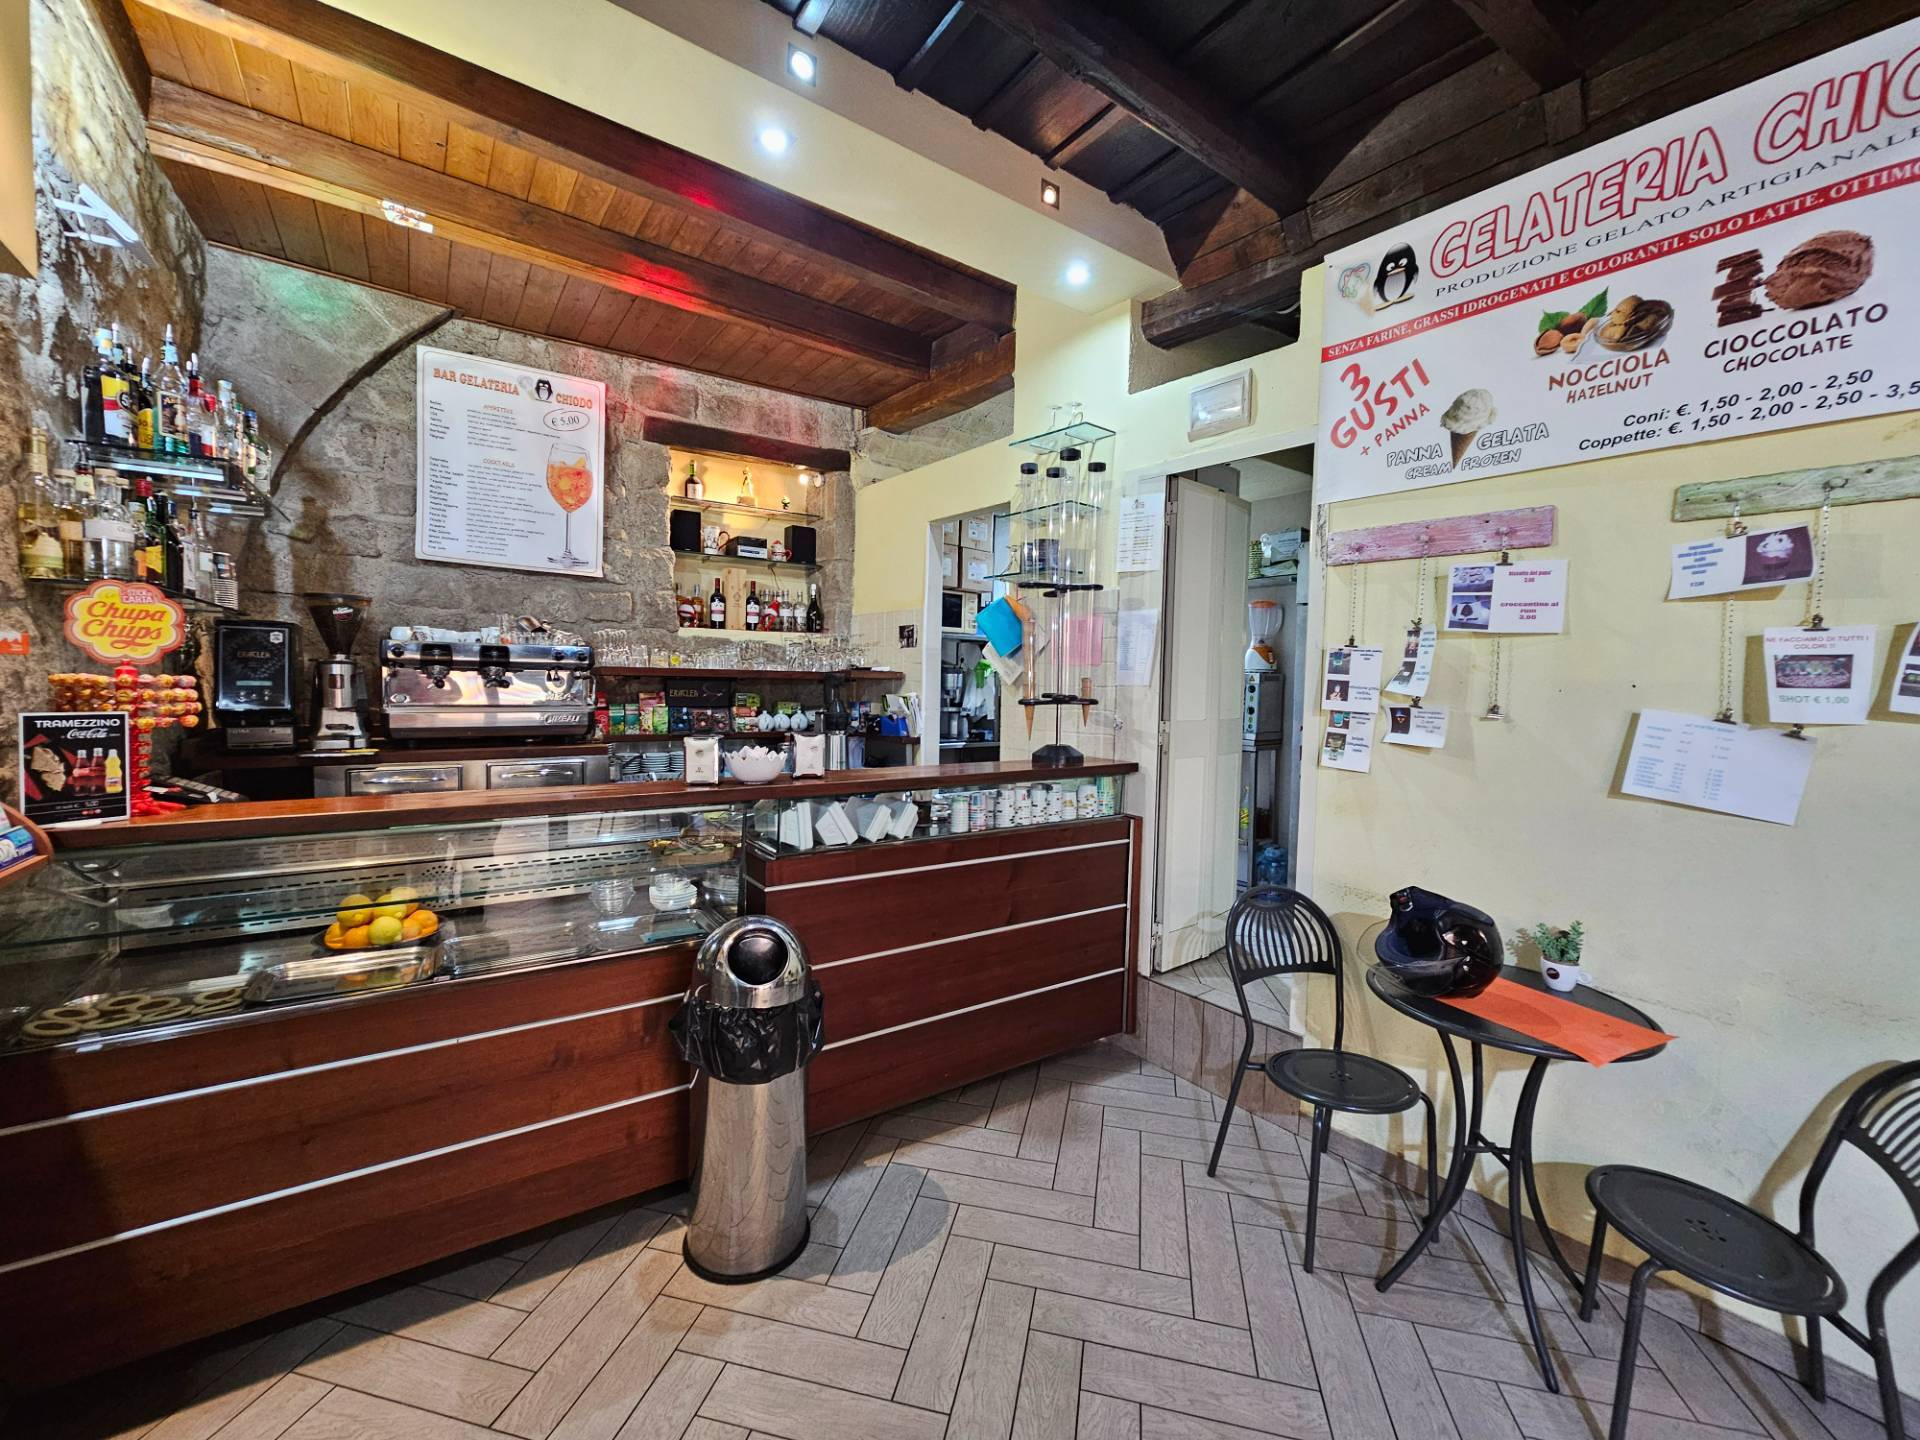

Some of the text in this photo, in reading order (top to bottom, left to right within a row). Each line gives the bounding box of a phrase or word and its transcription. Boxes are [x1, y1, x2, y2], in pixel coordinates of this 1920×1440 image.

[1429, 125, 1729, 279] GELATERIA
[1435, 243, 1578, 298] PRODUZIONE
[1585, 204, 1691, 248] GELATO
[1327, 339, 1366, 359] SENZA
[1366, 322, 1413, 347] FARINE,
[1413, 305, 1460, 331] GRASSI
[1462, 276, 1556, 316] IDROGENATI
[1559, 270, 1571, 286] E
[1688, 213, 1744, 244] SOLO
[1746, 192, 1825, 229] LATTE.
[1703, 303, 1889, 359] CIOCCOLATO
[1548, 348, 1671, 392] NOCCIOLA
[1722, 333, 1854, 374] CHOCOLATE
[432, 368, 593, 410] BAR GELATERIA CHIODO
[1330, 357, 1430, 449] GUSTI
[1339, 362, 1371, 402] 3
[1566, 373, 1654, 404] HAZELNUT
[1623, 408, 1670, 427] Coni:
[1699, 393, 1739, 414] 1,50
[1759, 381, 1804, 402] 2,00
[1825, 369, 1873, 390] 2,50
[1374, 402, 1431, 447] PANNA
[1578, 427, 1663, 451] Coppette:
[1691, 413, 1731, 432] 1,50
[1750, 401, 1794, 421] 2,00
[1815, 389, 1863, 410] 2,50
[1386, 421, 1550, 467] PANNA GELATA
[1404, 447, 1522, 480] CREAM FROZEN
[82, 618, 162, 649] Chups
[87, 600, 167, 625] Chupa
[1778, 694, 1811, 704] SHOT
[34, 718, 120, 728] TRAMEZZINO
